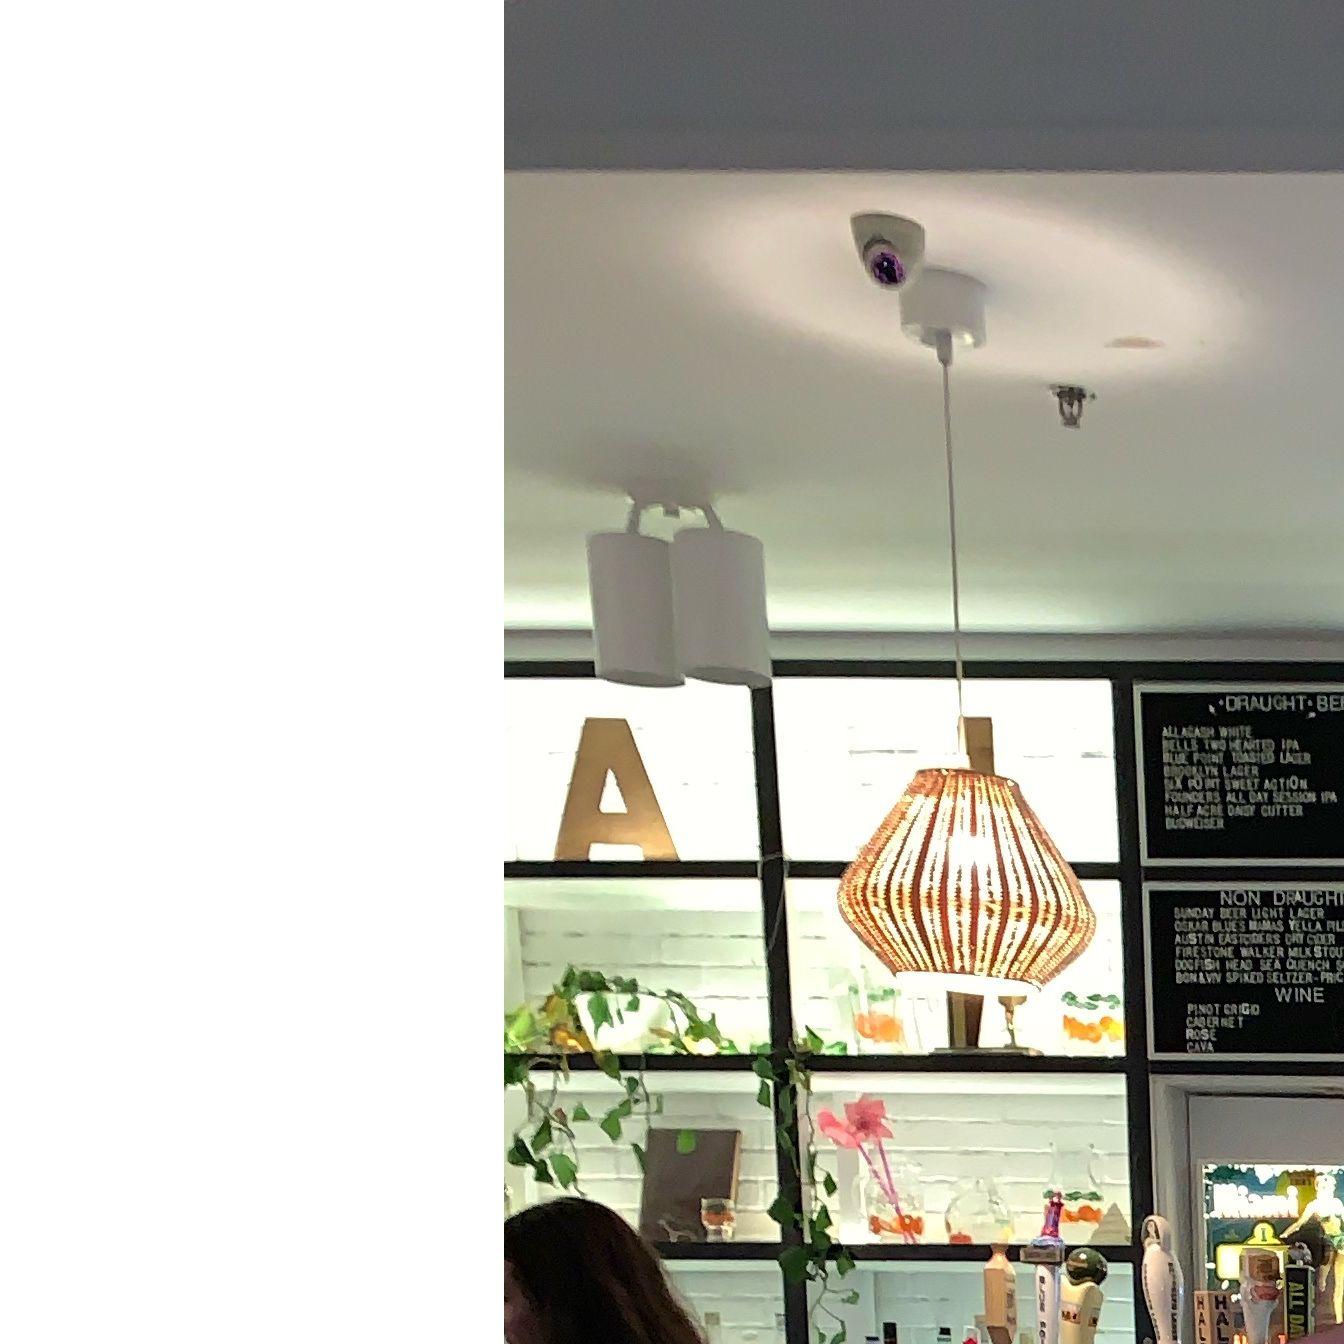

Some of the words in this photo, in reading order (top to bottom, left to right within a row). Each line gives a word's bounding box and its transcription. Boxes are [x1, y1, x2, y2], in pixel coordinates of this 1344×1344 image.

[1220, 890, 1261, 907] NON
[1174, 933, 1215, 945] AUSTIN
[1175, 946, 1235, 958] FIRESTONE
[1240, 946, 1285, 958] WALKER
[1274, 987, 1325, 1003] WINE
[1187, 1003, 1221, 1015] PINOT
